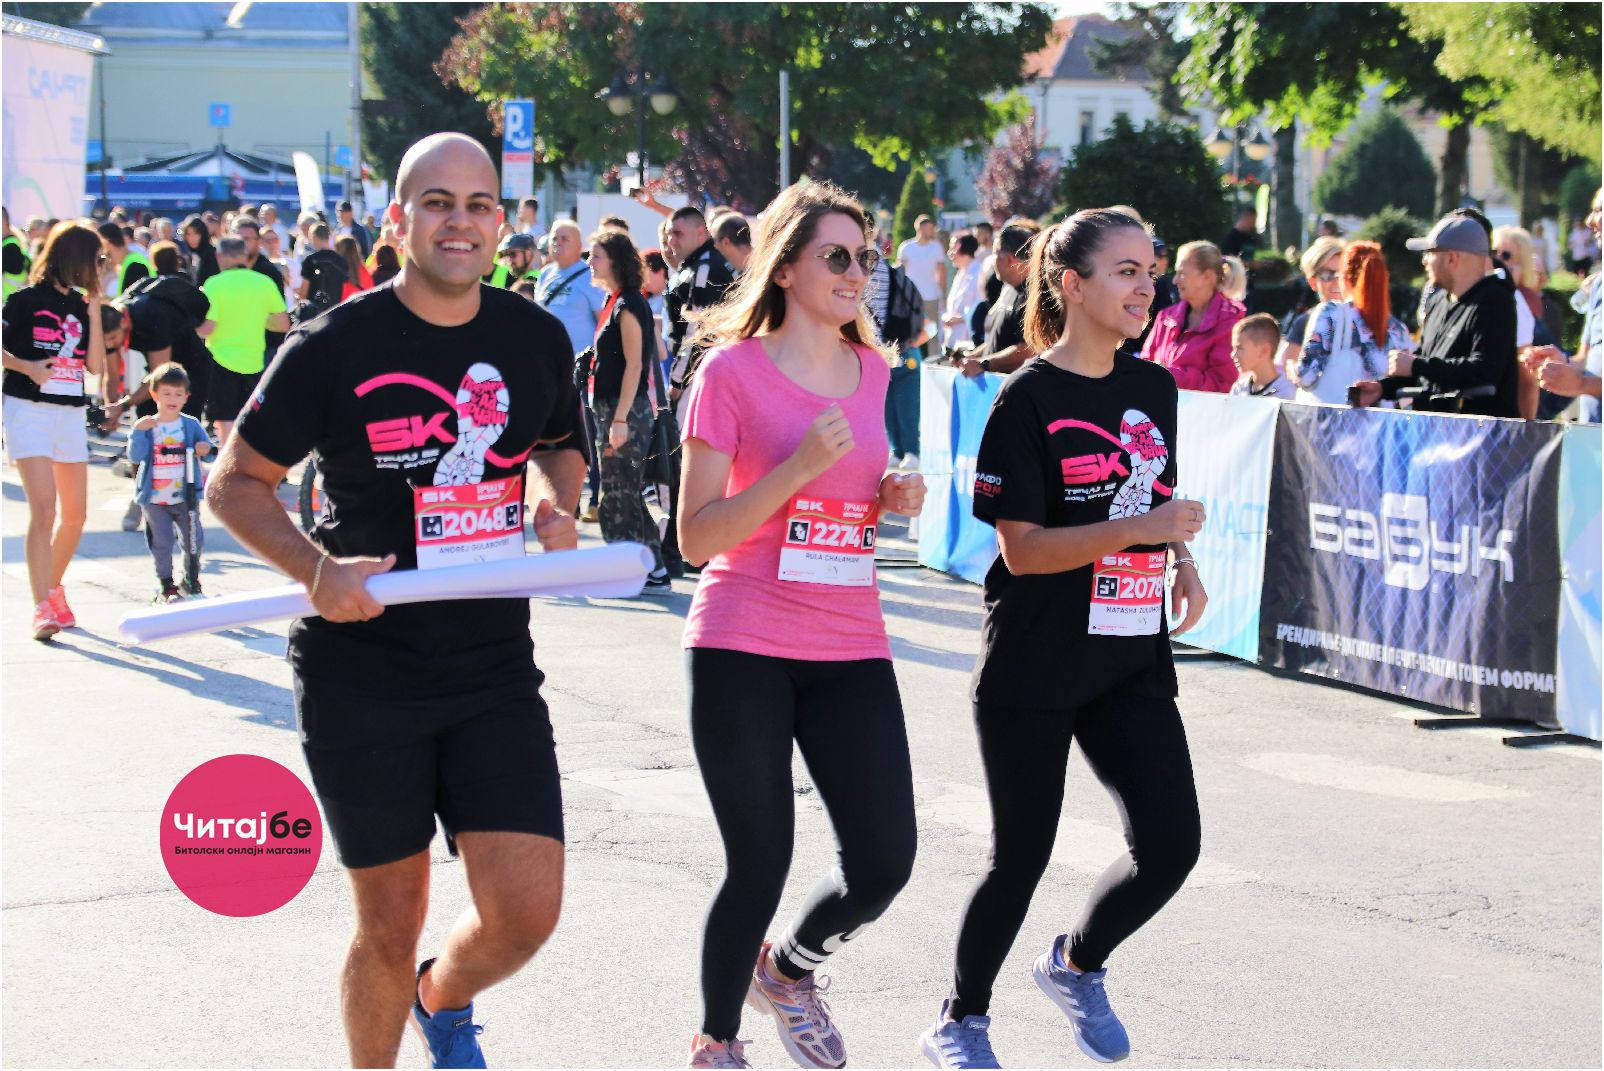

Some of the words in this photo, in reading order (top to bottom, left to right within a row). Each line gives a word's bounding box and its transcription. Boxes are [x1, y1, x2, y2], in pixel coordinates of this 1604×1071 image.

[444, 506, 505, 538] 2048
[812, 521, 861, 548] 2274
[1120, 576, 1163, 599] 2078
